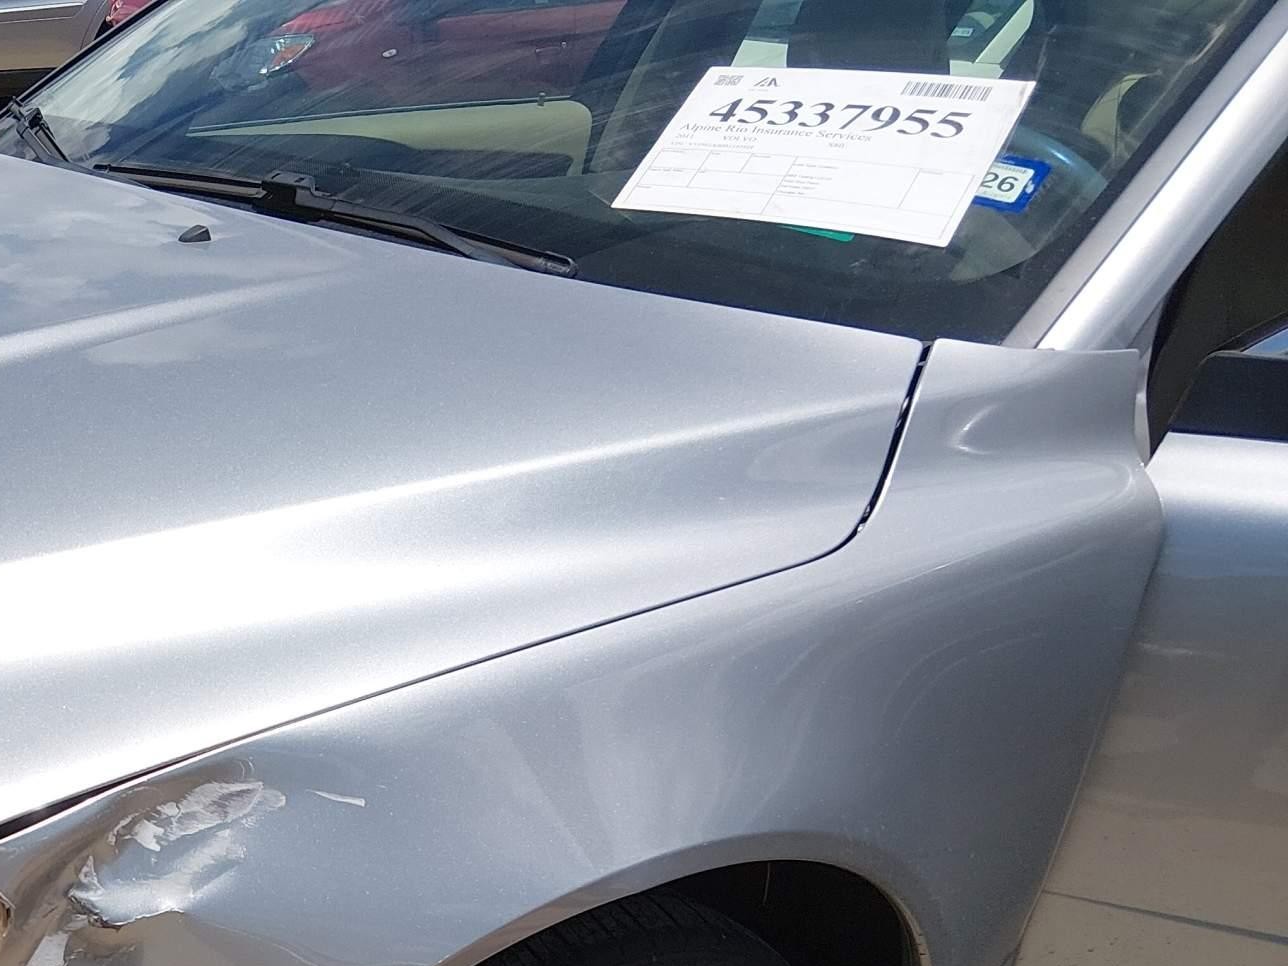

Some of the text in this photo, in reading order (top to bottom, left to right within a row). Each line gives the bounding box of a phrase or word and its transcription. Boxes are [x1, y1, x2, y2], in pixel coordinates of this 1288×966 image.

[709, 98, 973, 139] 45337955
[679, 123, 872, 142] Alpine Rio Insurance Services
[980, 171, 1019, 193] 26
